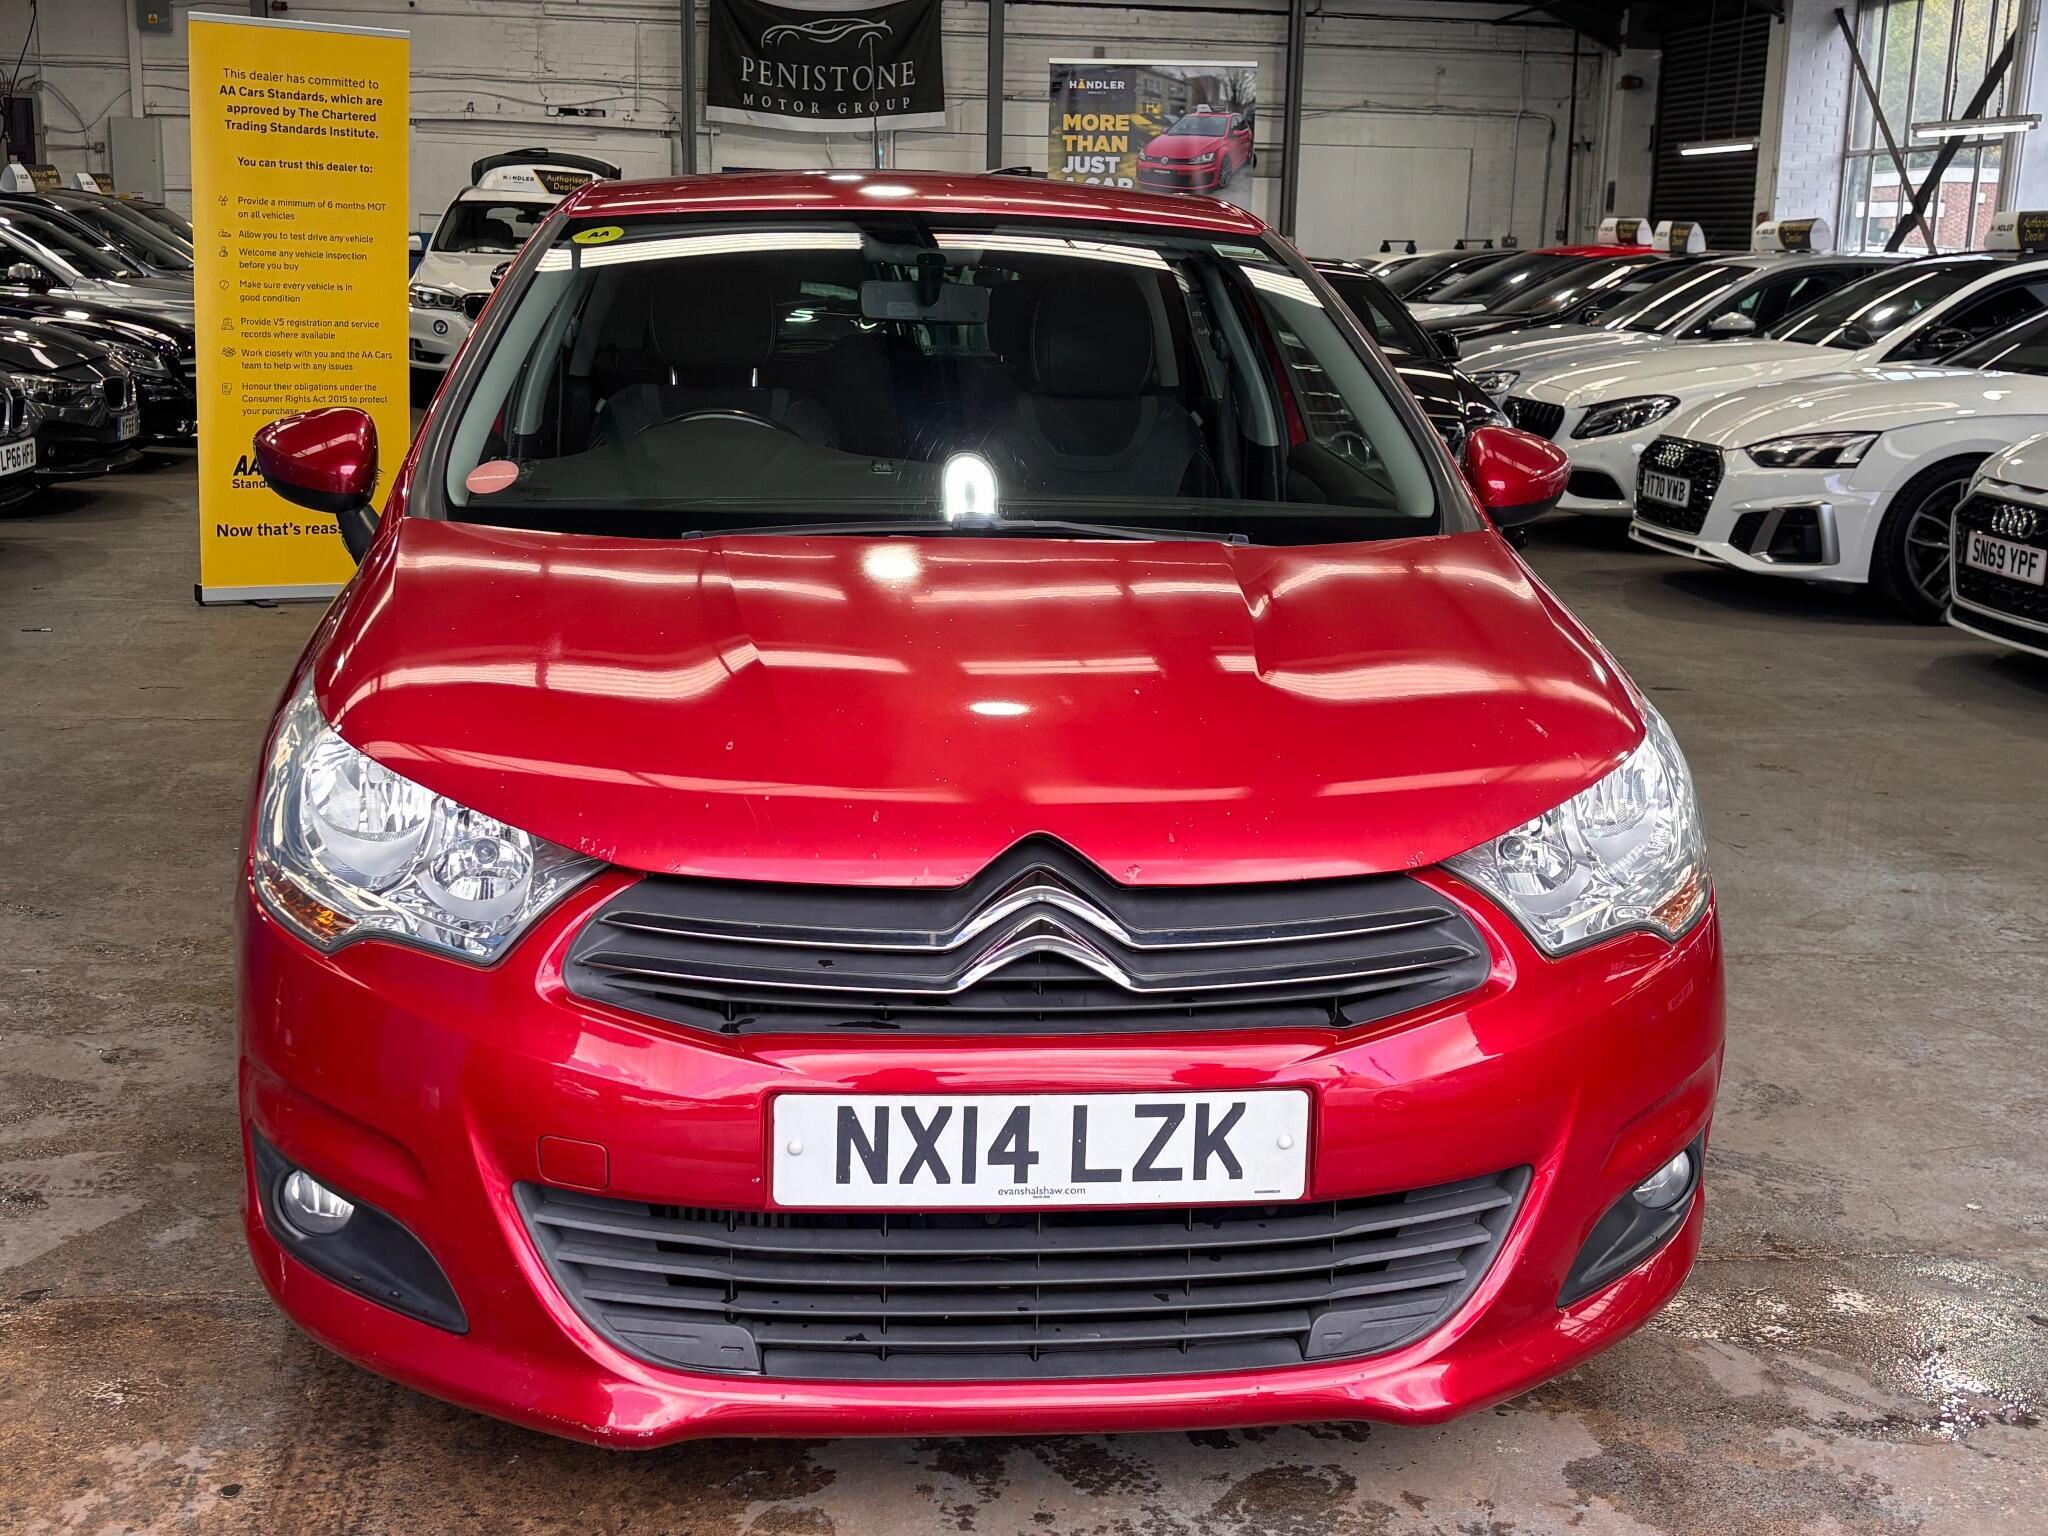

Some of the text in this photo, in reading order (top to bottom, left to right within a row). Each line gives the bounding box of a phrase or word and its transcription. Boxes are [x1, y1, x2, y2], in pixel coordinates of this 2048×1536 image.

[223, 68, 378, 89] This dealer has committed to
[741, 55, 916, 92] PENISTONE
[220, 85, 382, 106] AA Cars Standards, which are
[743, 93, 910, 114] MOTOR GROUP
[227, 104, 376, 122] approved by The Chartered
[225, 120, 378, 138] Trading Standards Institute.
[1063, 114, 1129, 131] MORE
[1063, 135, 1127, 152] THAN
[237, 157, 256, 166] You
[279, 160, 303, 169] trust
[306, 161, 324, 170] this
[327, 162, 357, 172] dealer
[360, 164, 373, 173] to:
[1062, 156, 1120, 174] JUST
[238, 197, 268, 205] Provide
[278, 199, 315, 208] minimum
[336, 202, 365, 210] months
[368, 203, 386, 211] MOT
[262, 212, 295, 220] vehicles
[239, 230, 261, 238] Allow
[308, 233, 327, 241] drive
[330, 235, 343, 243] any
[346, 235, 373, 243] vehicle
[239, 248, 277, 256] Welcome
[295, 250, 323, 258] vehicle
[326, 251, 367, 260] inspection
[239, 261, 265, 269] before
[284, 263, 298, 271] buy
[307, 282, 334, 290] vehicle
[240, 294, 260, 302] good
[241, 318, 271, 326] Provide
[287, 319, 332, 328] registration
[241, 330, 271, 338] records
[301, 331, 335, 339] available
[241, 349, 263, 357] Work
[265, 350, 292, 358] closely
[375, 351, 392, 359] Cars
[274, 362, 291, 370] help
[295, 383, 337, 393] obligations
[242, 395, 282, 403] Consumer
[287, 395, 311, 404] Rights
[0, 446, 20, 471] LP66
[217, 524, 252, 537] Now
[1973, 538, 2038, 577] SN69 YPF
[836, 1102, 1246, 1184] NX14 LZK
[998, 1186, 1086, 1196] evanshalshaw.com
